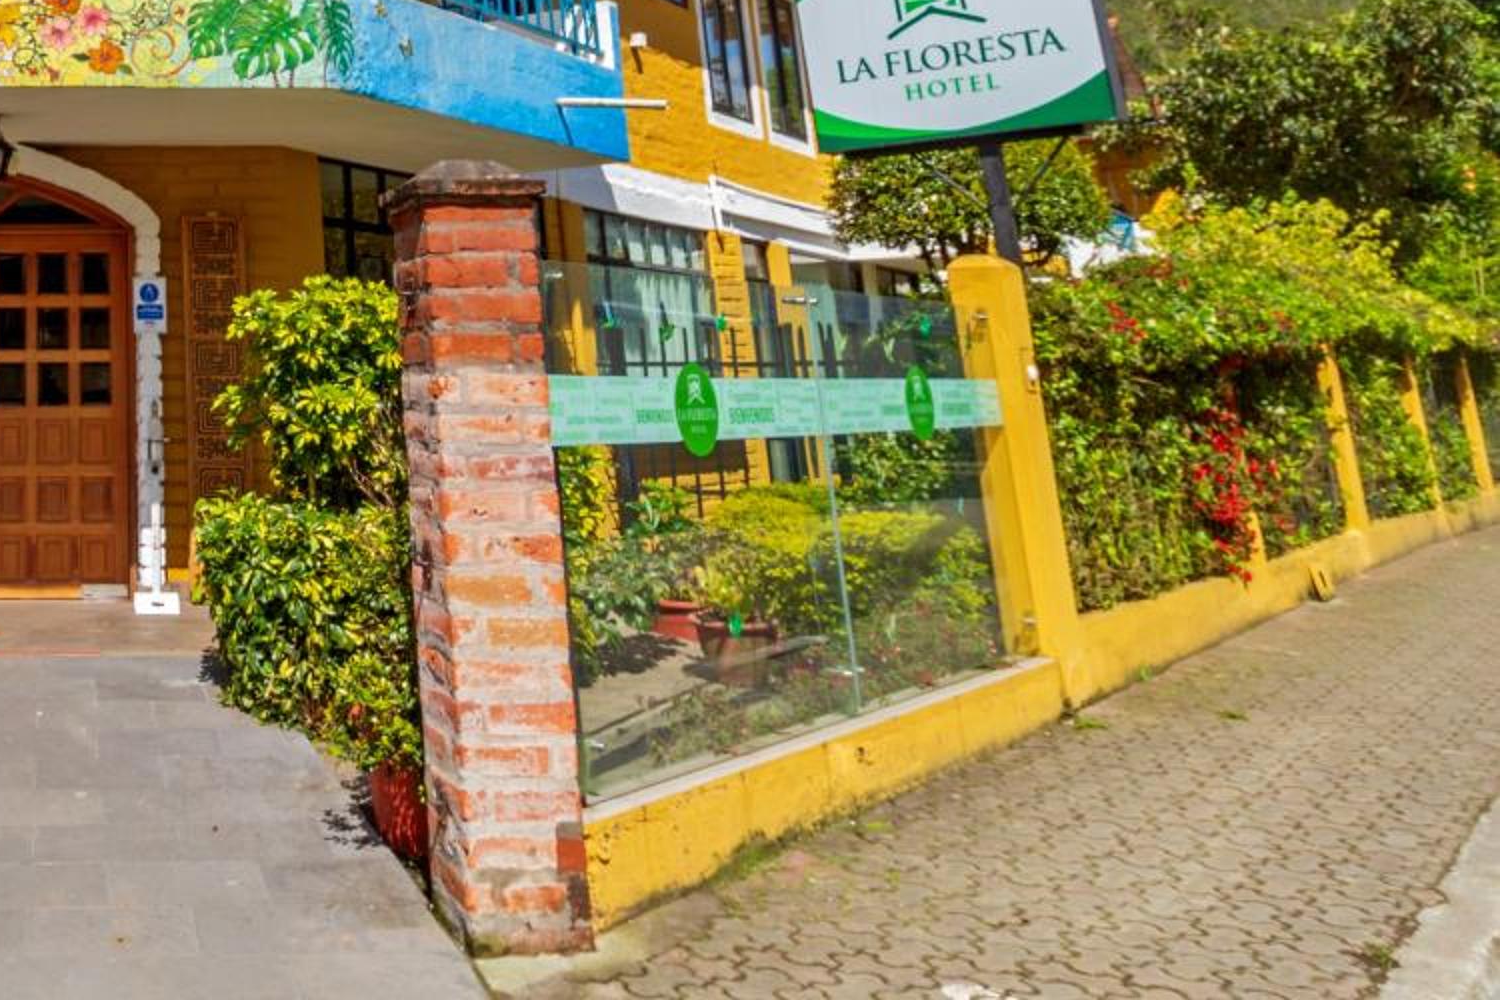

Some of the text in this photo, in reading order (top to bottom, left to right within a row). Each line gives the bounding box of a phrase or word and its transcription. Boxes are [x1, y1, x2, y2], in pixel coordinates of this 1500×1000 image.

[836, 28, 1066, 85] LA FLORESTA
[905, 73, 999, 100] HOTEL
